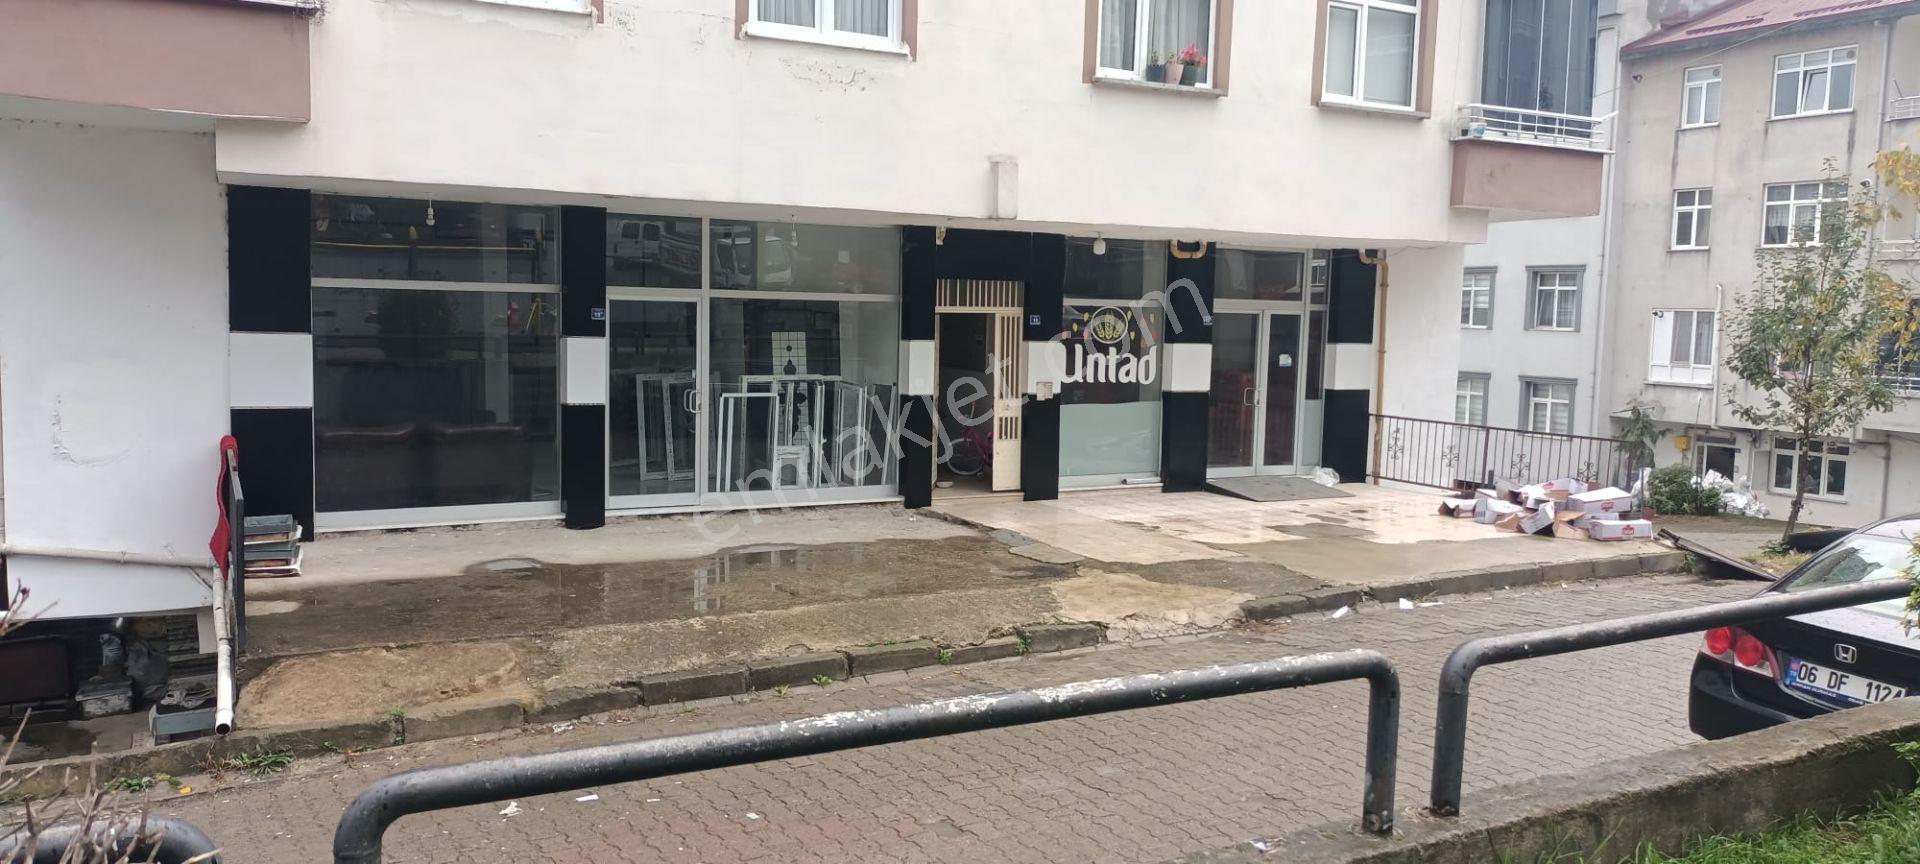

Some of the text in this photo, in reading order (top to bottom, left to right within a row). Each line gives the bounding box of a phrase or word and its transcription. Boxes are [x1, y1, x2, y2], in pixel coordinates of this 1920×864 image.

[1060, 343, 1158, 385] Untad
[1798, 663, 1819, 683] 06
[1827, 671, 1849, 691] DF
